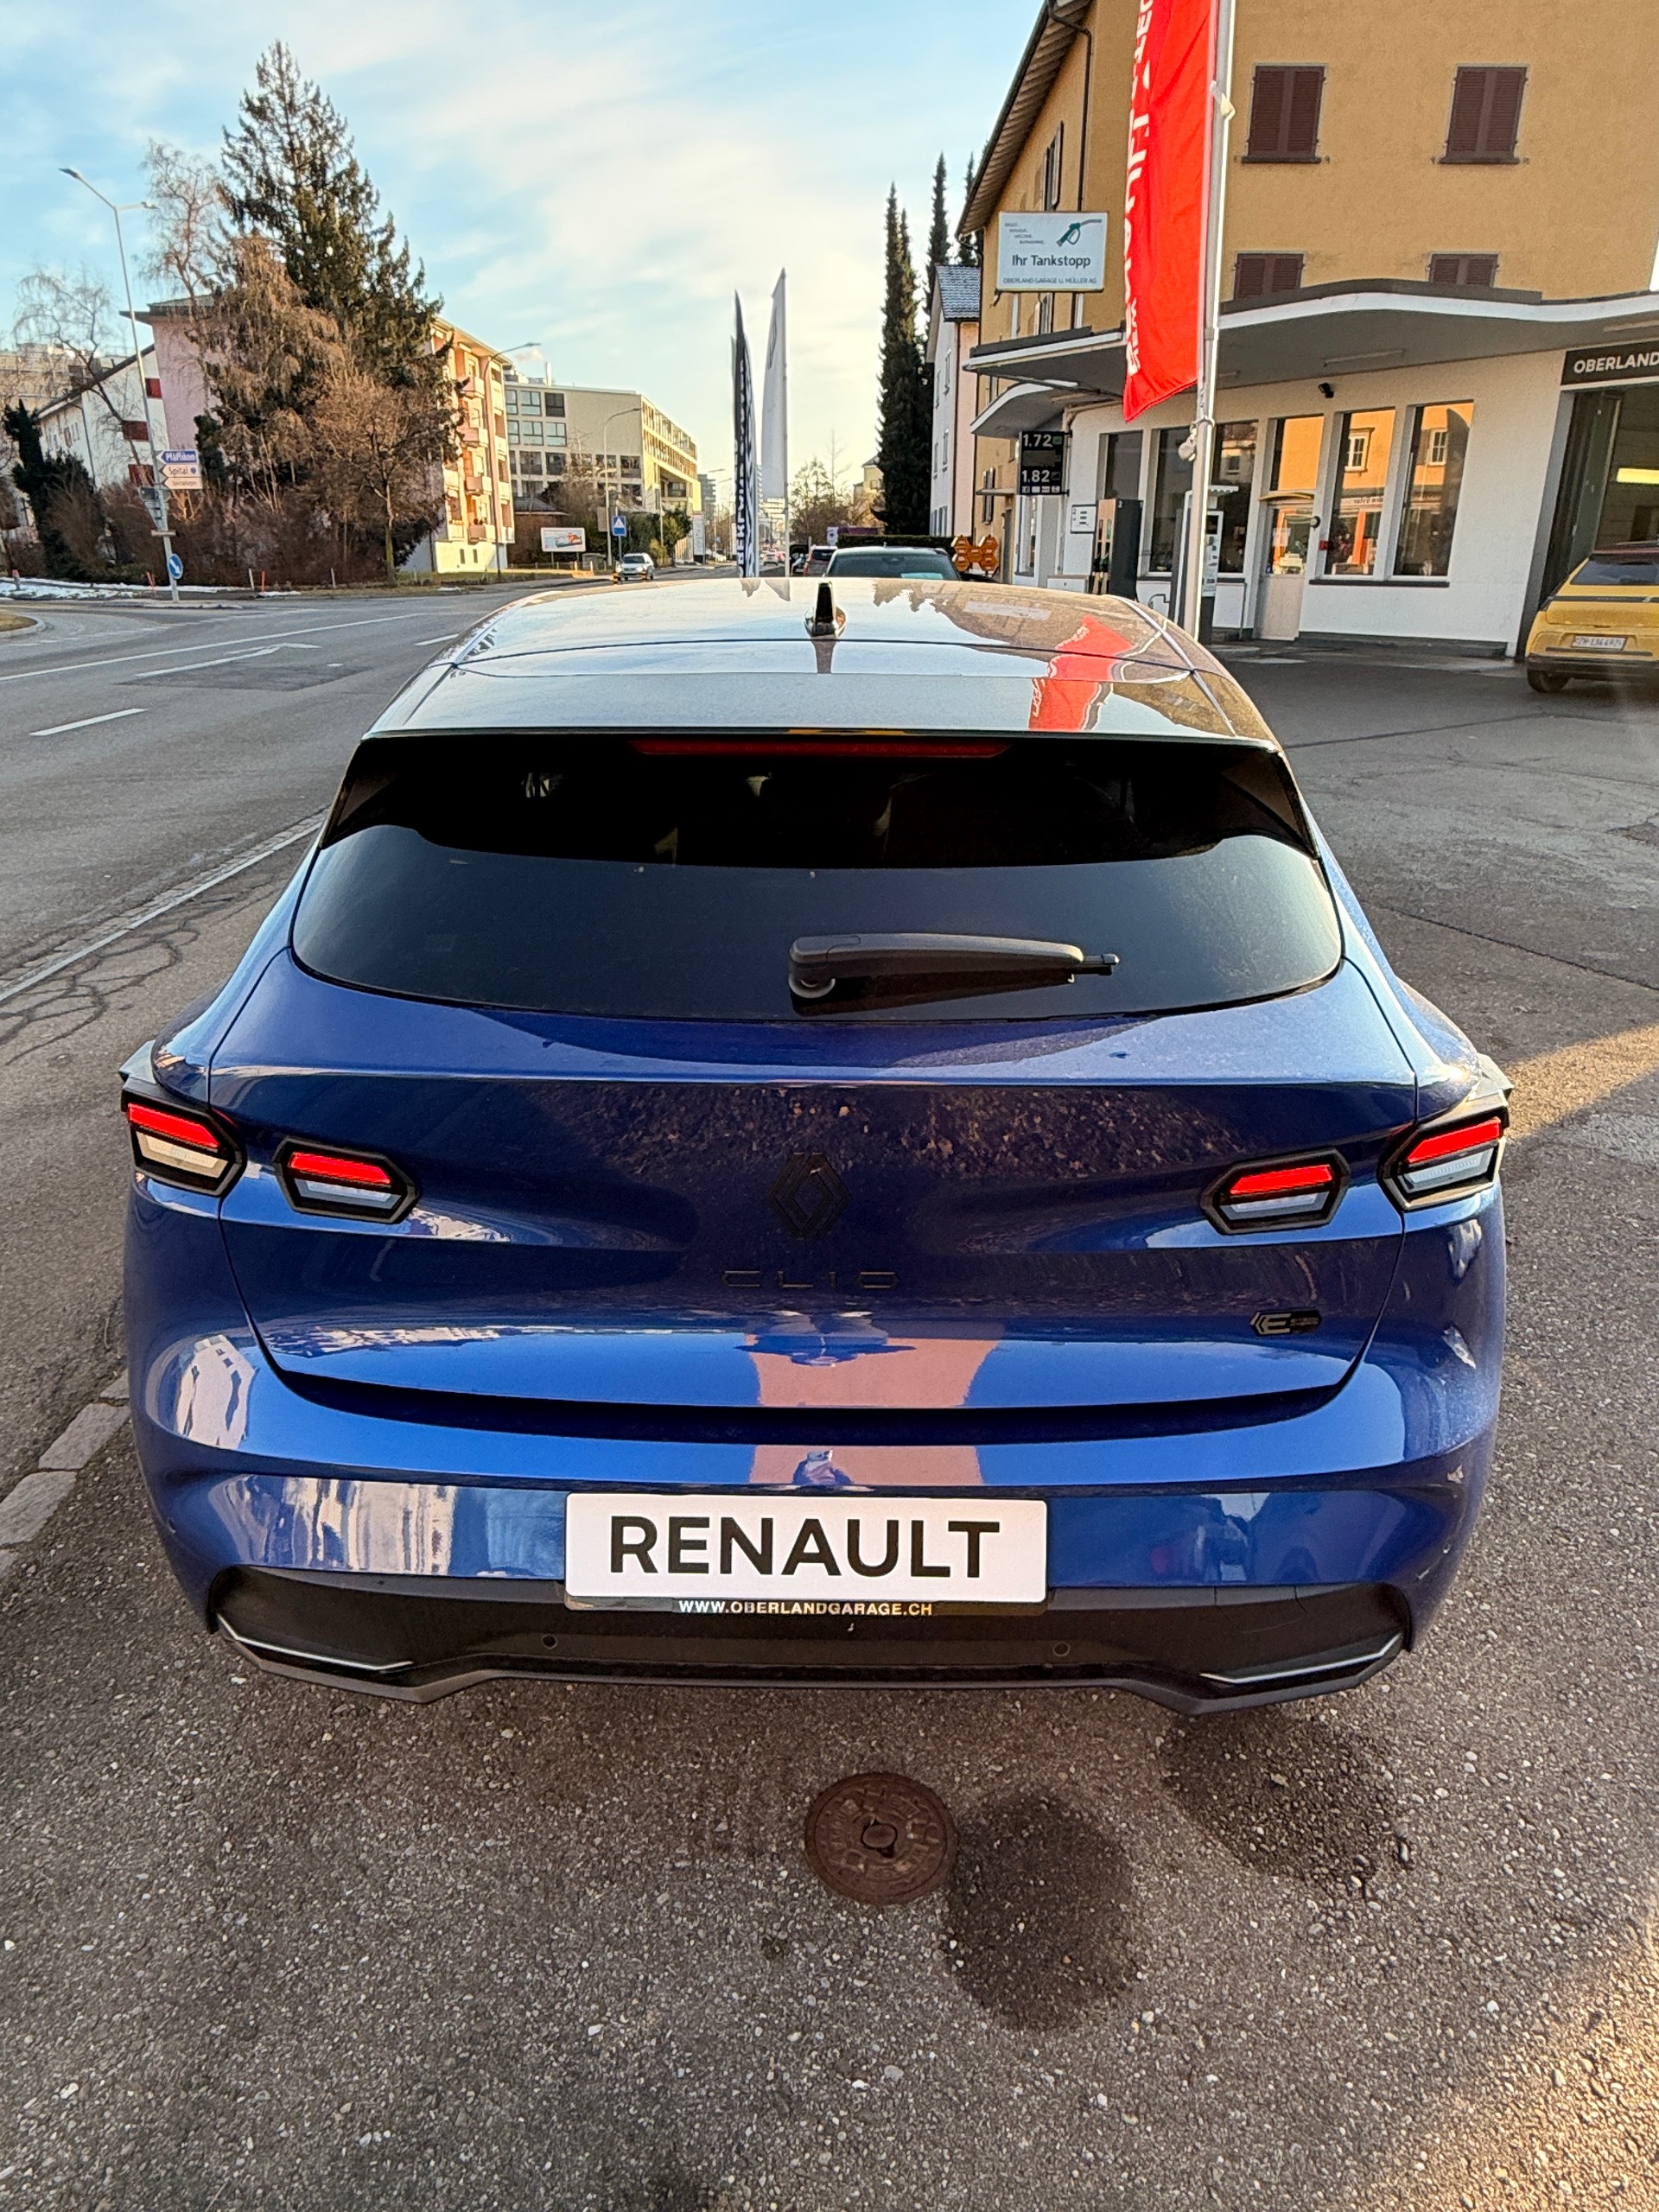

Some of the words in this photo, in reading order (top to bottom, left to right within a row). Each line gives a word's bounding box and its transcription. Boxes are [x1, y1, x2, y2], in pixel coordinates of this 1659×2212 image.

[1012, 254, 1027, 266] Ihr
[1030, 254, 1091, 270] Tankstopp
[1573, 351, 1659, 373] OBERLAND
[1023, 434, 1053, 448] 1.72
[1022, 469, 1051, 483] 1.82
[721, 1269, 900, 1289] CLIO
[610, 1515, 1001, 1579] RENAULT
[678, 1599, 932, 1617] WWW.OBERLANDGARAGE.CH
